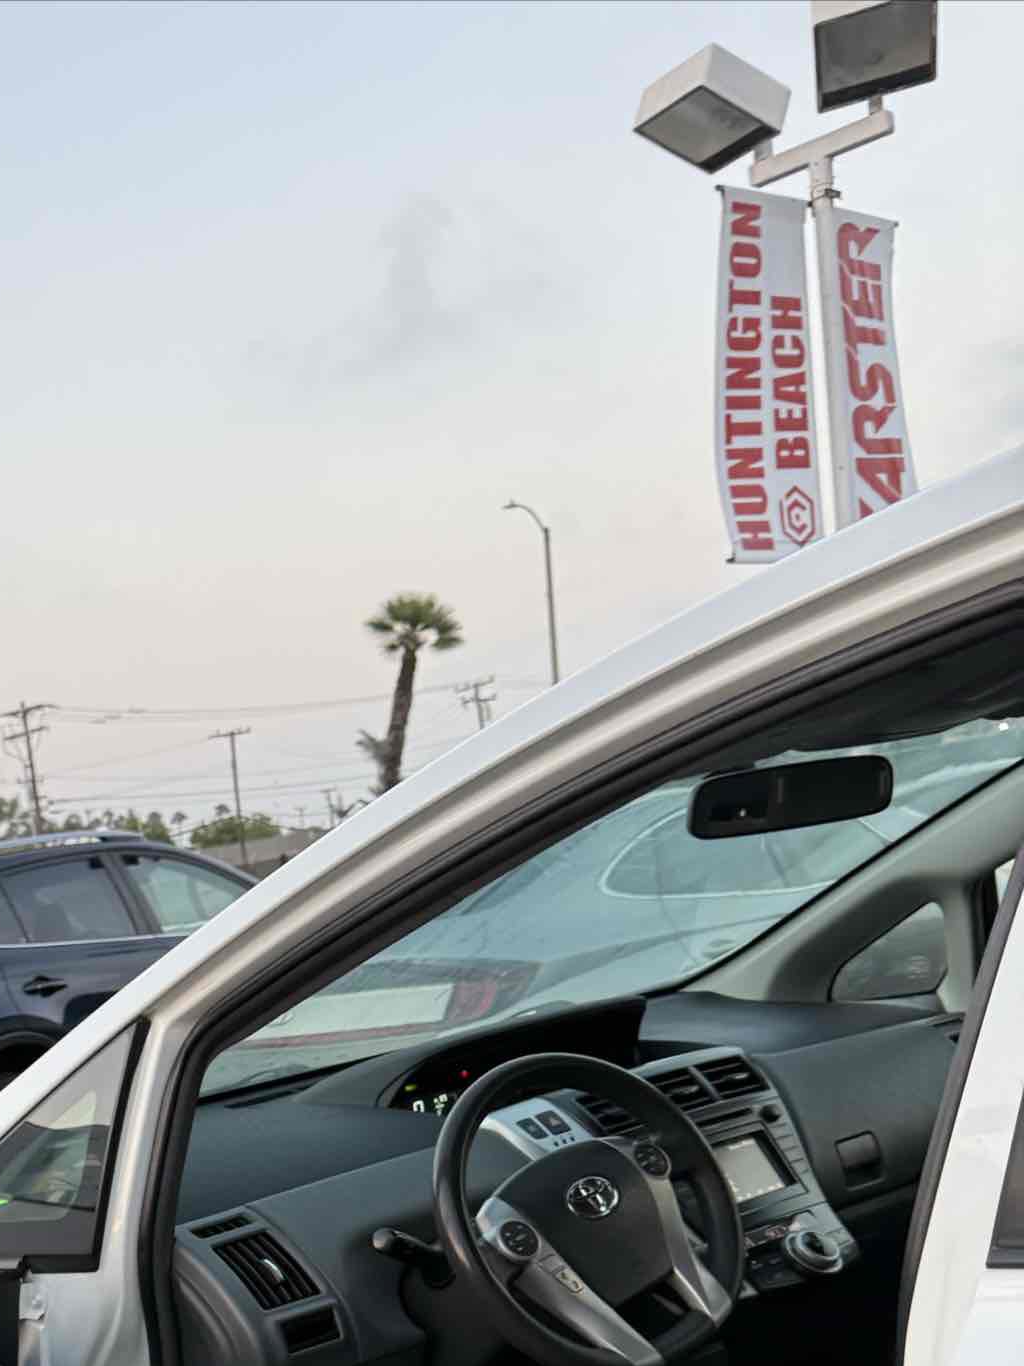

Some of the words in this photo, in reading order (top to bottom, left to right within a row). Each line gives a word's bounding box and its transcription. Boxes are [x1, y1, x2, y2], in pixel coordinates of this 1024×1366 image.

[724, 201, 774, 550] HUNTINGTON
[771, 296, 811, 470] BEACH
[837, 222, 906, 518] ARSTER
